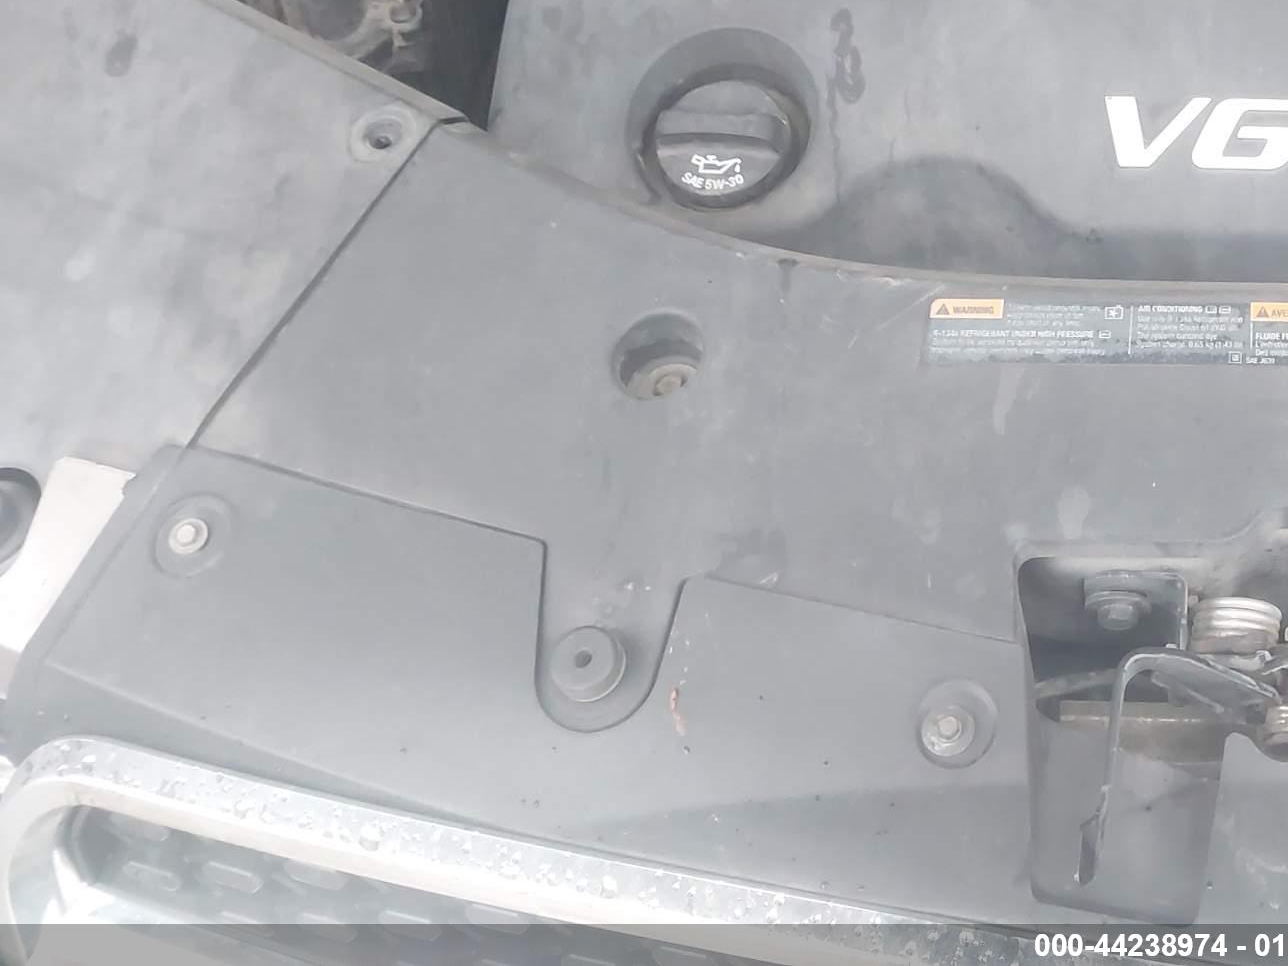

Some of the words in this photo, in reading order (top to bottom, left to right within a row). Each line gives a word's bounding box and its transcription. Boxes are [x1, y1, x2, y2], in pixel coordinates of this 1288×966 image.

[681, 172, 705, 189] SAE
[953, 306, 994, 314] WARNING
[1138, 305, 1151, 313] AIR
[1152, 305, 1203, 313] CONDITIONING
